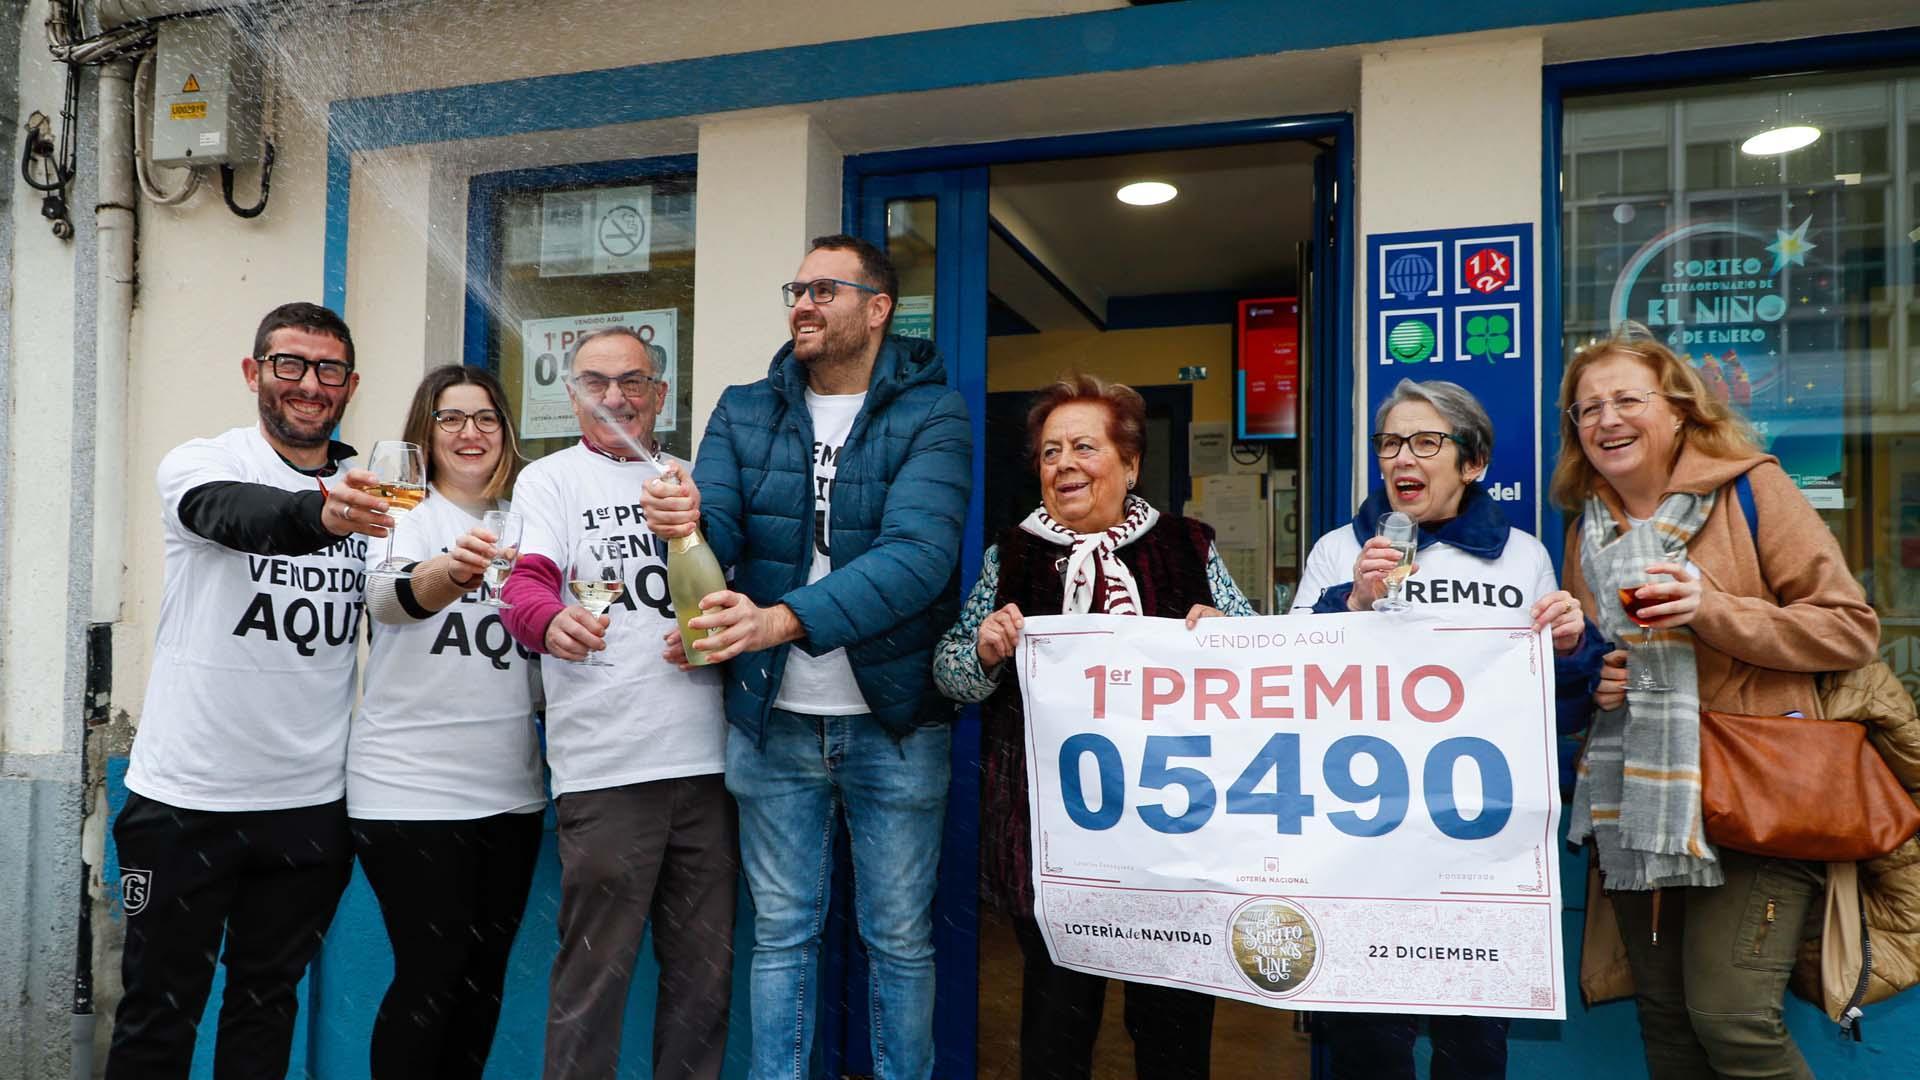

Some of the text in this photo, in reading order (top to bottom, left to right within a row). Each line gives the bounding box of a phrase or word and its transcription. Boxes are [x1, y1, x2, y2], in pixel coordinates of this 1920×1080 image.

[1673, 257, 1762, 278] SORTEO
[1661, 279, 1773, 293] EXTRAORDINARIO DE
[1647, 294, 1787, 326] EL NIÑO
[1667, 328, 1766, 345] 6 DE ENERO
[248, 555, 367, 593] VENDIDO
[1399, 579, 1524, 609] REMIO
[1195, 626, 1346, 649] VENDIDO AQUÍ
[1141, 664, 1465, 723] PREMIO
[1058, 732, 1515, 841] 05490
[1268, 876, 1309, 884] NACIONAL
[1368, 945, 1500, 962] 22 DICIEMBRE
